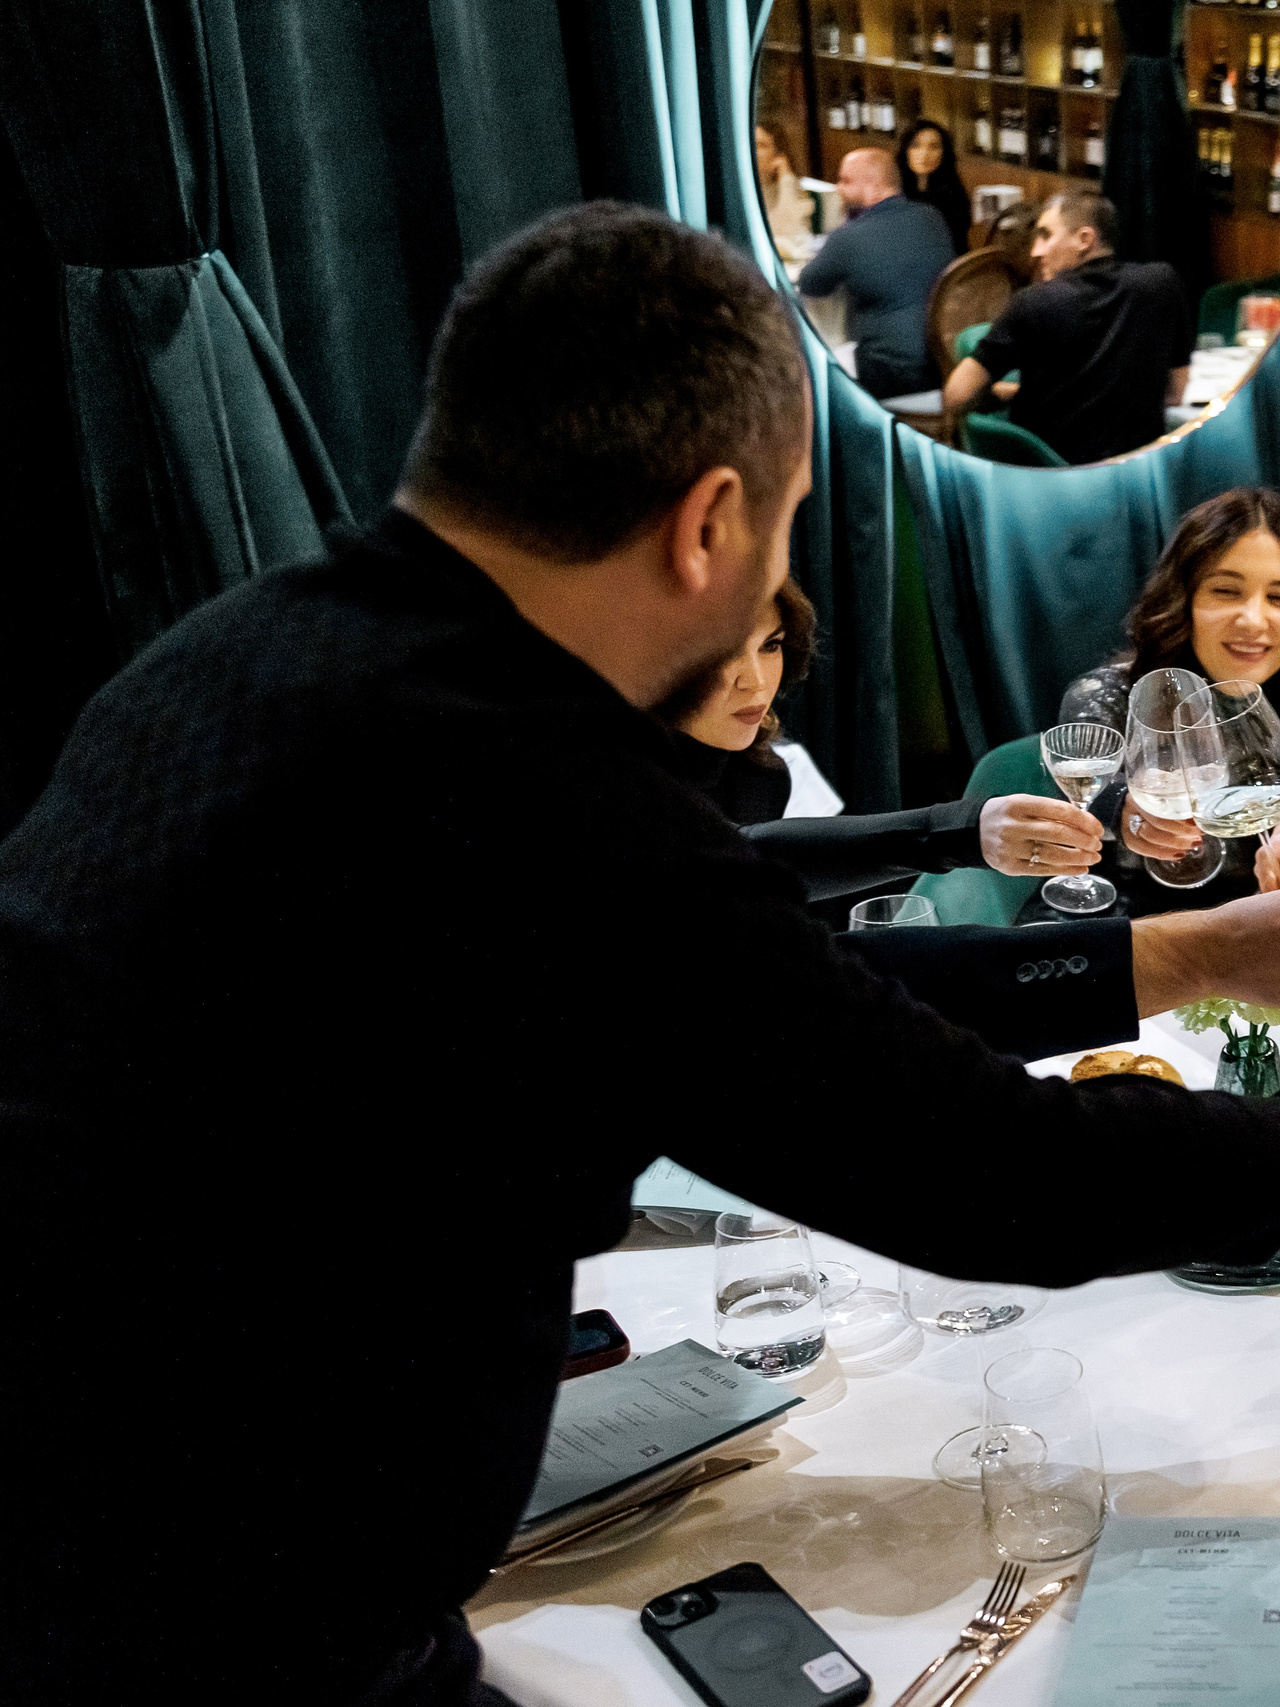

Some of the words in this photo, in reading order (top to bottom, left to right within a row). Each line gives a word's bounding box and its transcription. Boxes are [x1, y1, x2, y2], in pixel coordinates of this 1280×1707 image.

[698, 1366, 725, 1381] DOLCE
[720, 1378, 739, 1389] VITA
[1174, 1529, 1211, 1539] DOLCE
[1216, 1529, 1240, 1538] VITA
